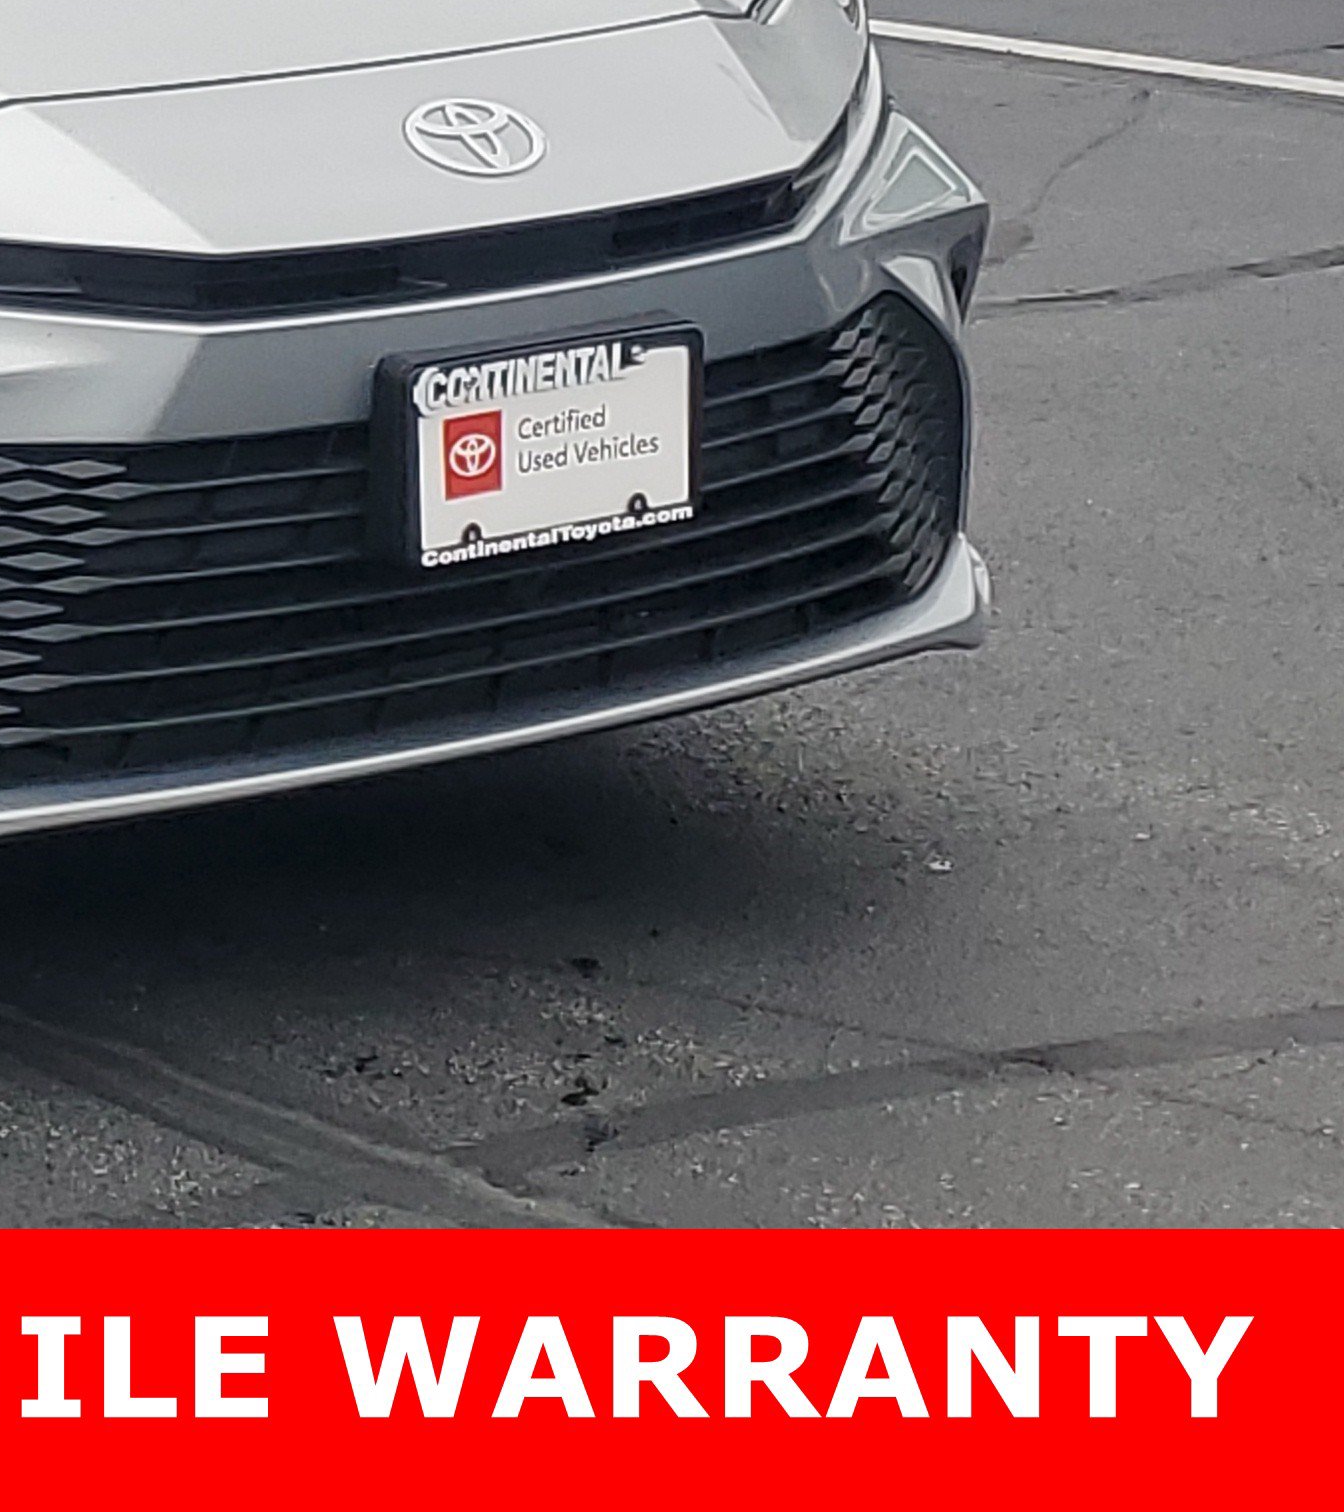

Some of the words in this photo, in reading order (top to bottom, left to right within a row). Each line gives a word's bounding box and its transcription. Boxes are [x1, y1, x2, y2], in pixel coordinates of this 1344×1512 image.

[421, 342, 627, 411] CONTINENTAL
[517, 403, 606, 439] Certified
[518, 443, 568, 473] Used
[574, 433, 659, 464] Vehicles
[420, 506, 693, 567] ContinentalToyota.com
